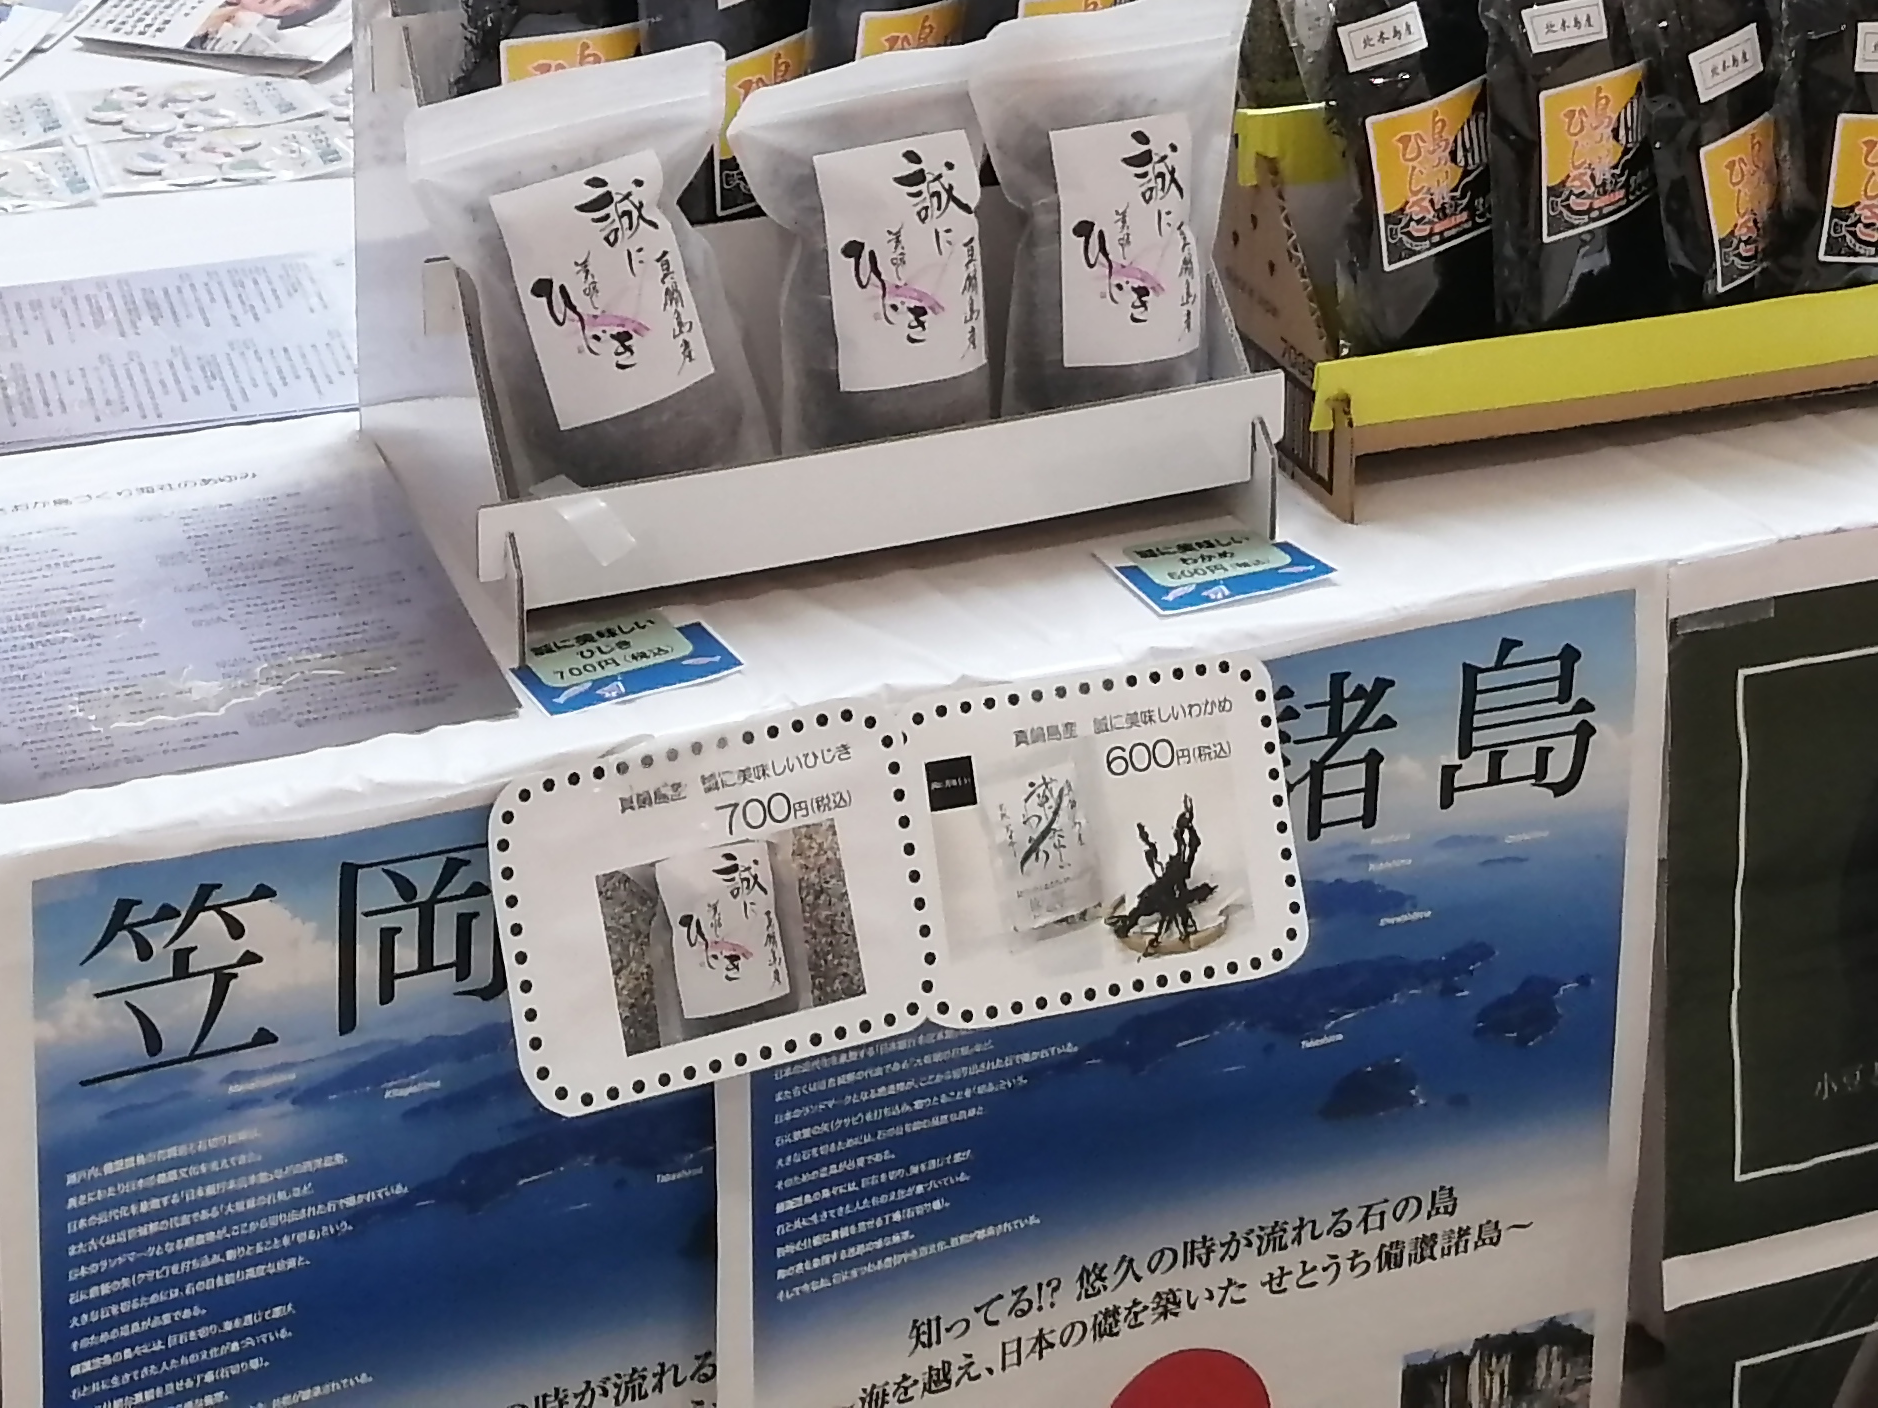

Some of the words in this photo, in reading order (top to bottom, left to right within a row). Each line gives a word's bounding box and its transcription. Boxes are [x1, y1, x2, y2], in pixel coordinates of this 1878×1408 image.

[574, 176, 660, 278] 誠に
[893, 149, 974, 256] 誠に
[1121, 130, 1185, 237] 誠に
[840, 239, 928, 344] ひじき
[1072, 220, 1151, 324] ひじき
[530, 277, 638, 370] ひじき
[1180, 550, 1235, 566] わかめ
[576, 639, 632, 660] ひじき
[1093, 697, 1233, 735] 誠に美味しいわかめ
[699, 742, 853, 795] 誠に美味しいひじき
[1076, 1184, 1460, 1303] 悠久の時が流れる石の島
